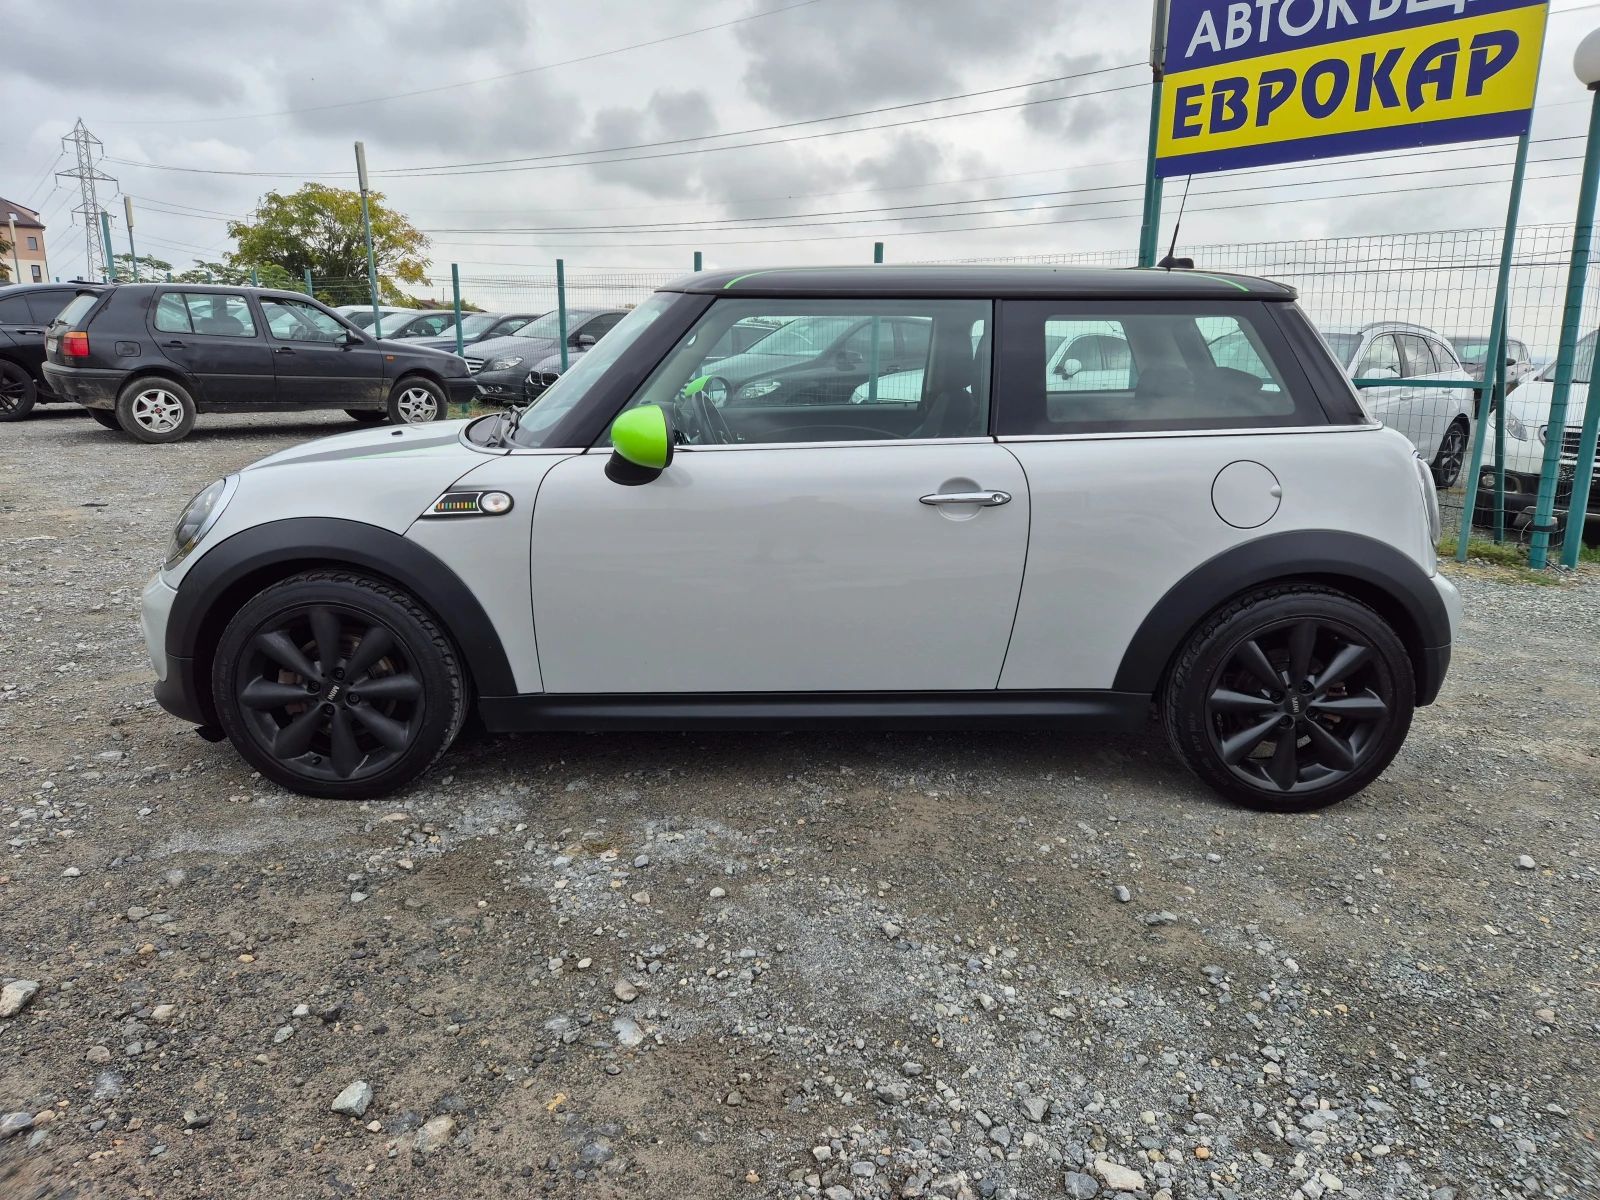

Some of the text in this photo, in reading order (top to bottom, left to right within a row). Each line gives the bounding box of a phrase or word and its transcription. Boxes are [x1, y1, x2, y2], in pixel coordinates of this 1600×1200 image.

[1171, 29, 1520, 140] ЕВРОКАР
[327, 685, 340, 701] MINI
[1291, 697, 1300, 713] MINI
